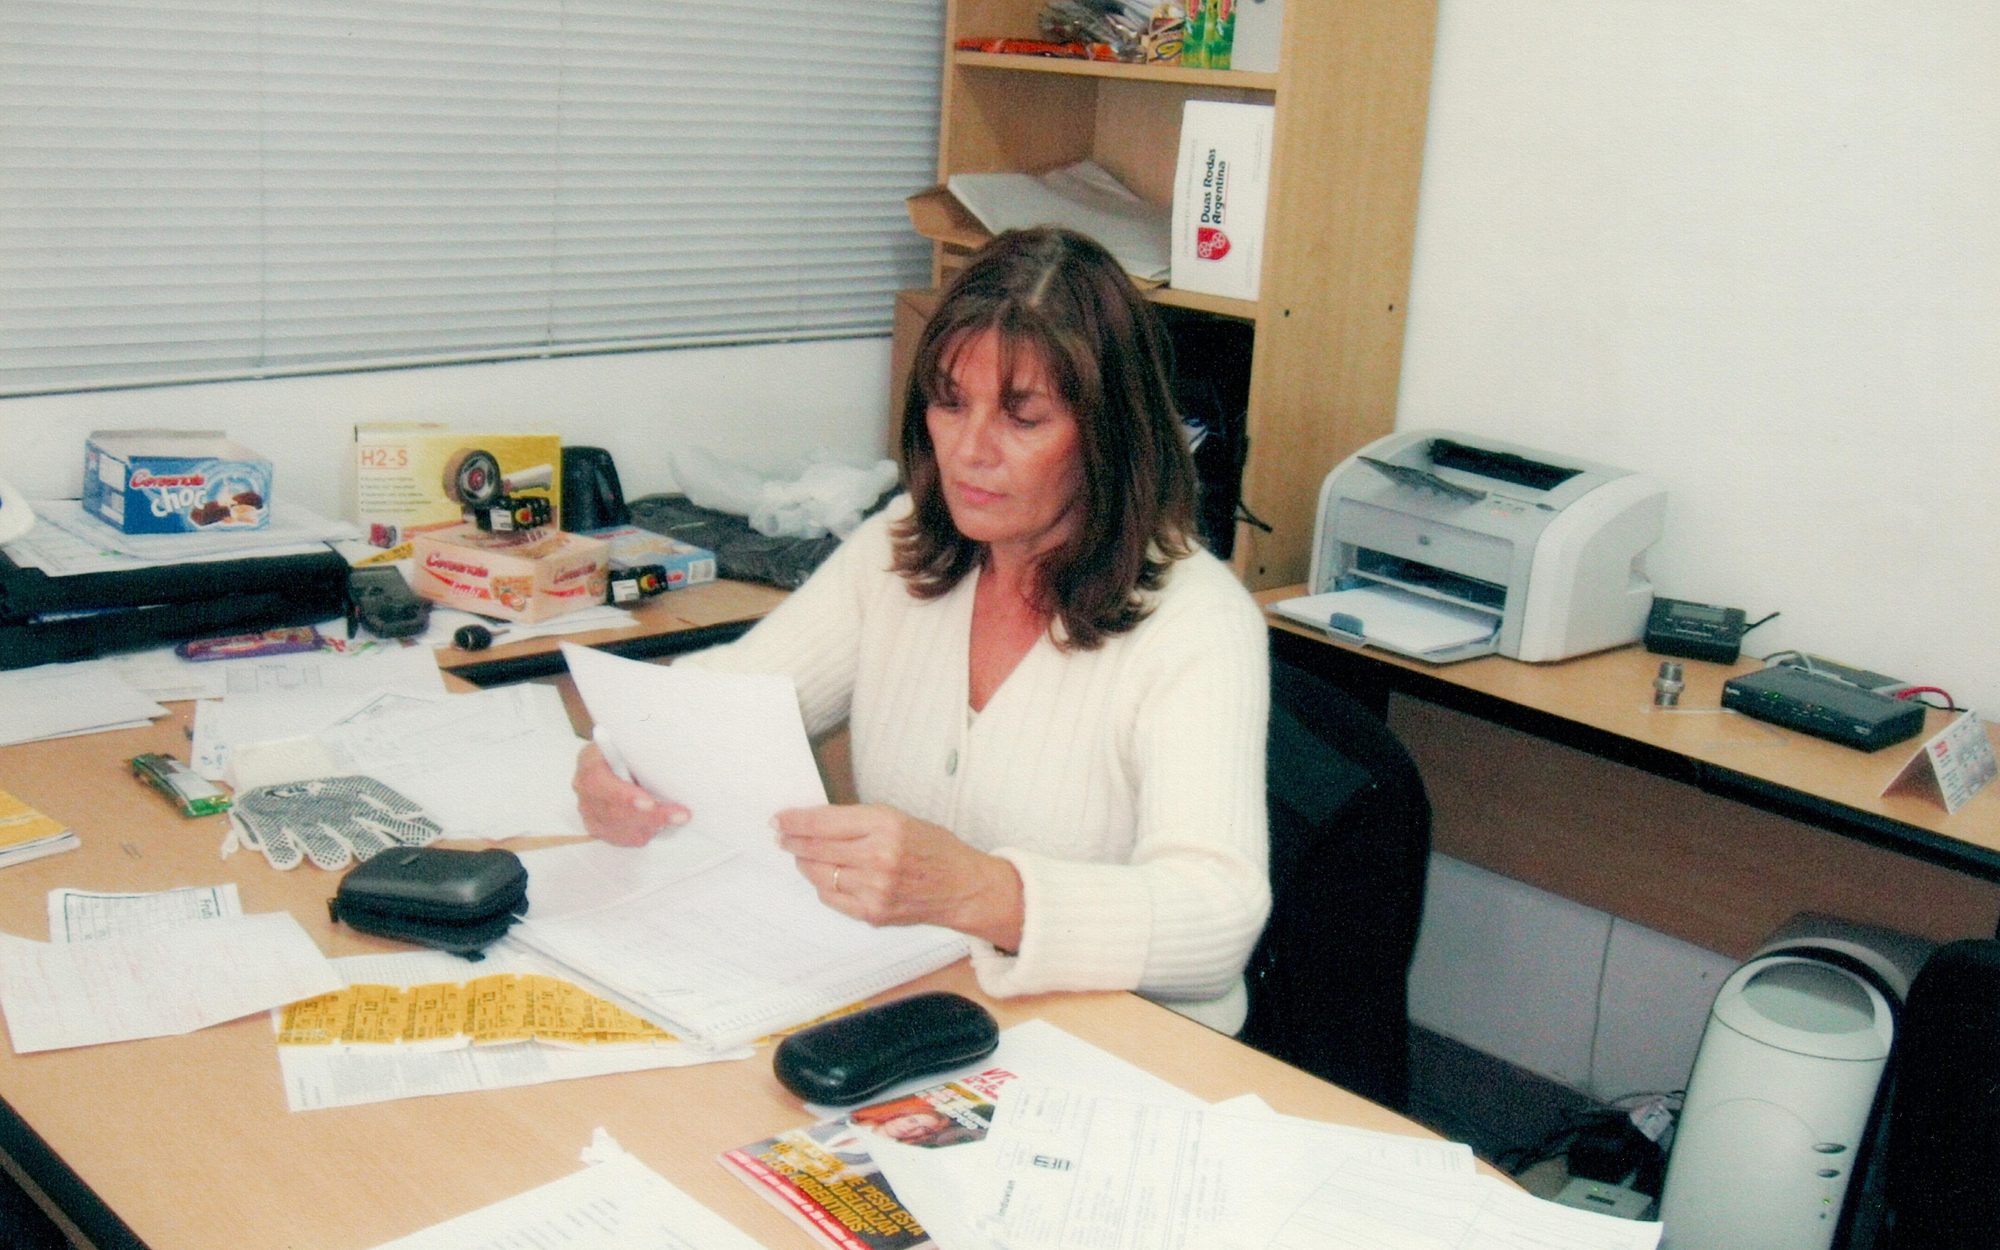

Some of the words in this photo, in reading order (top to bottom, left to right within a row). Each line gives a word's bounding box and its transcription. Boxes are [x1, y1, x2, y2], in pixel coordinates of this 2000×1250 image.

[1203, 149, 1217, 188] Rodas
[1201, 191, 1213, 223] Duas
[1212, 160, 1227, 224] Argentina
[360, 448, 407, 467] H2-S
[151, 486, 207, 518] choc
[824, 1180, 901, 1237] ADELGAZAR
[858, 1184, 898, 1212] PESO
[888, 1210, 926, 1236] ESTA
